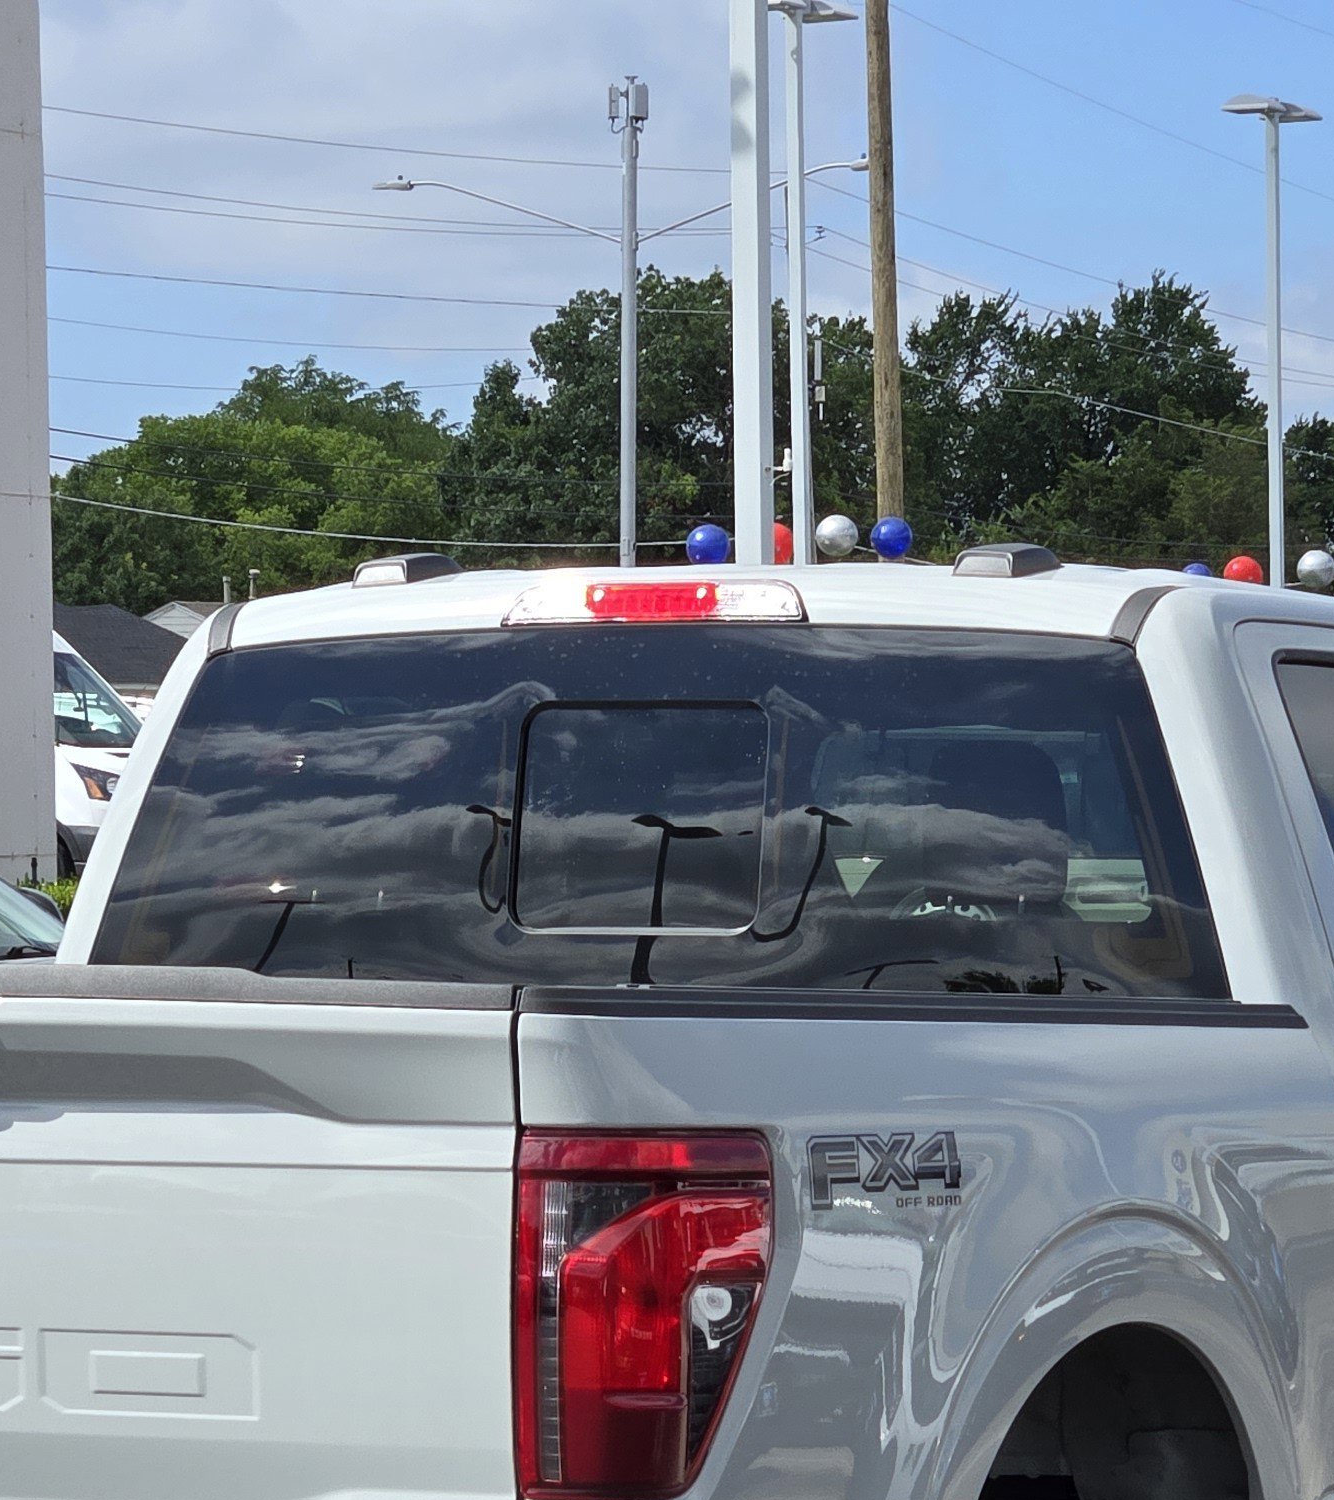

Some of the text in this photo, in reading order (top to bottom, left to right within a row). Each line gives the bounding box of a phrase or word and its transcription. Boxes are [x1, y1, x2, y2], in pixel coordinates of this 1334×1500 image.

[806, 1131, 962, 1211] FX4
[895, 1194, 962, 1208] OFF ROAD
